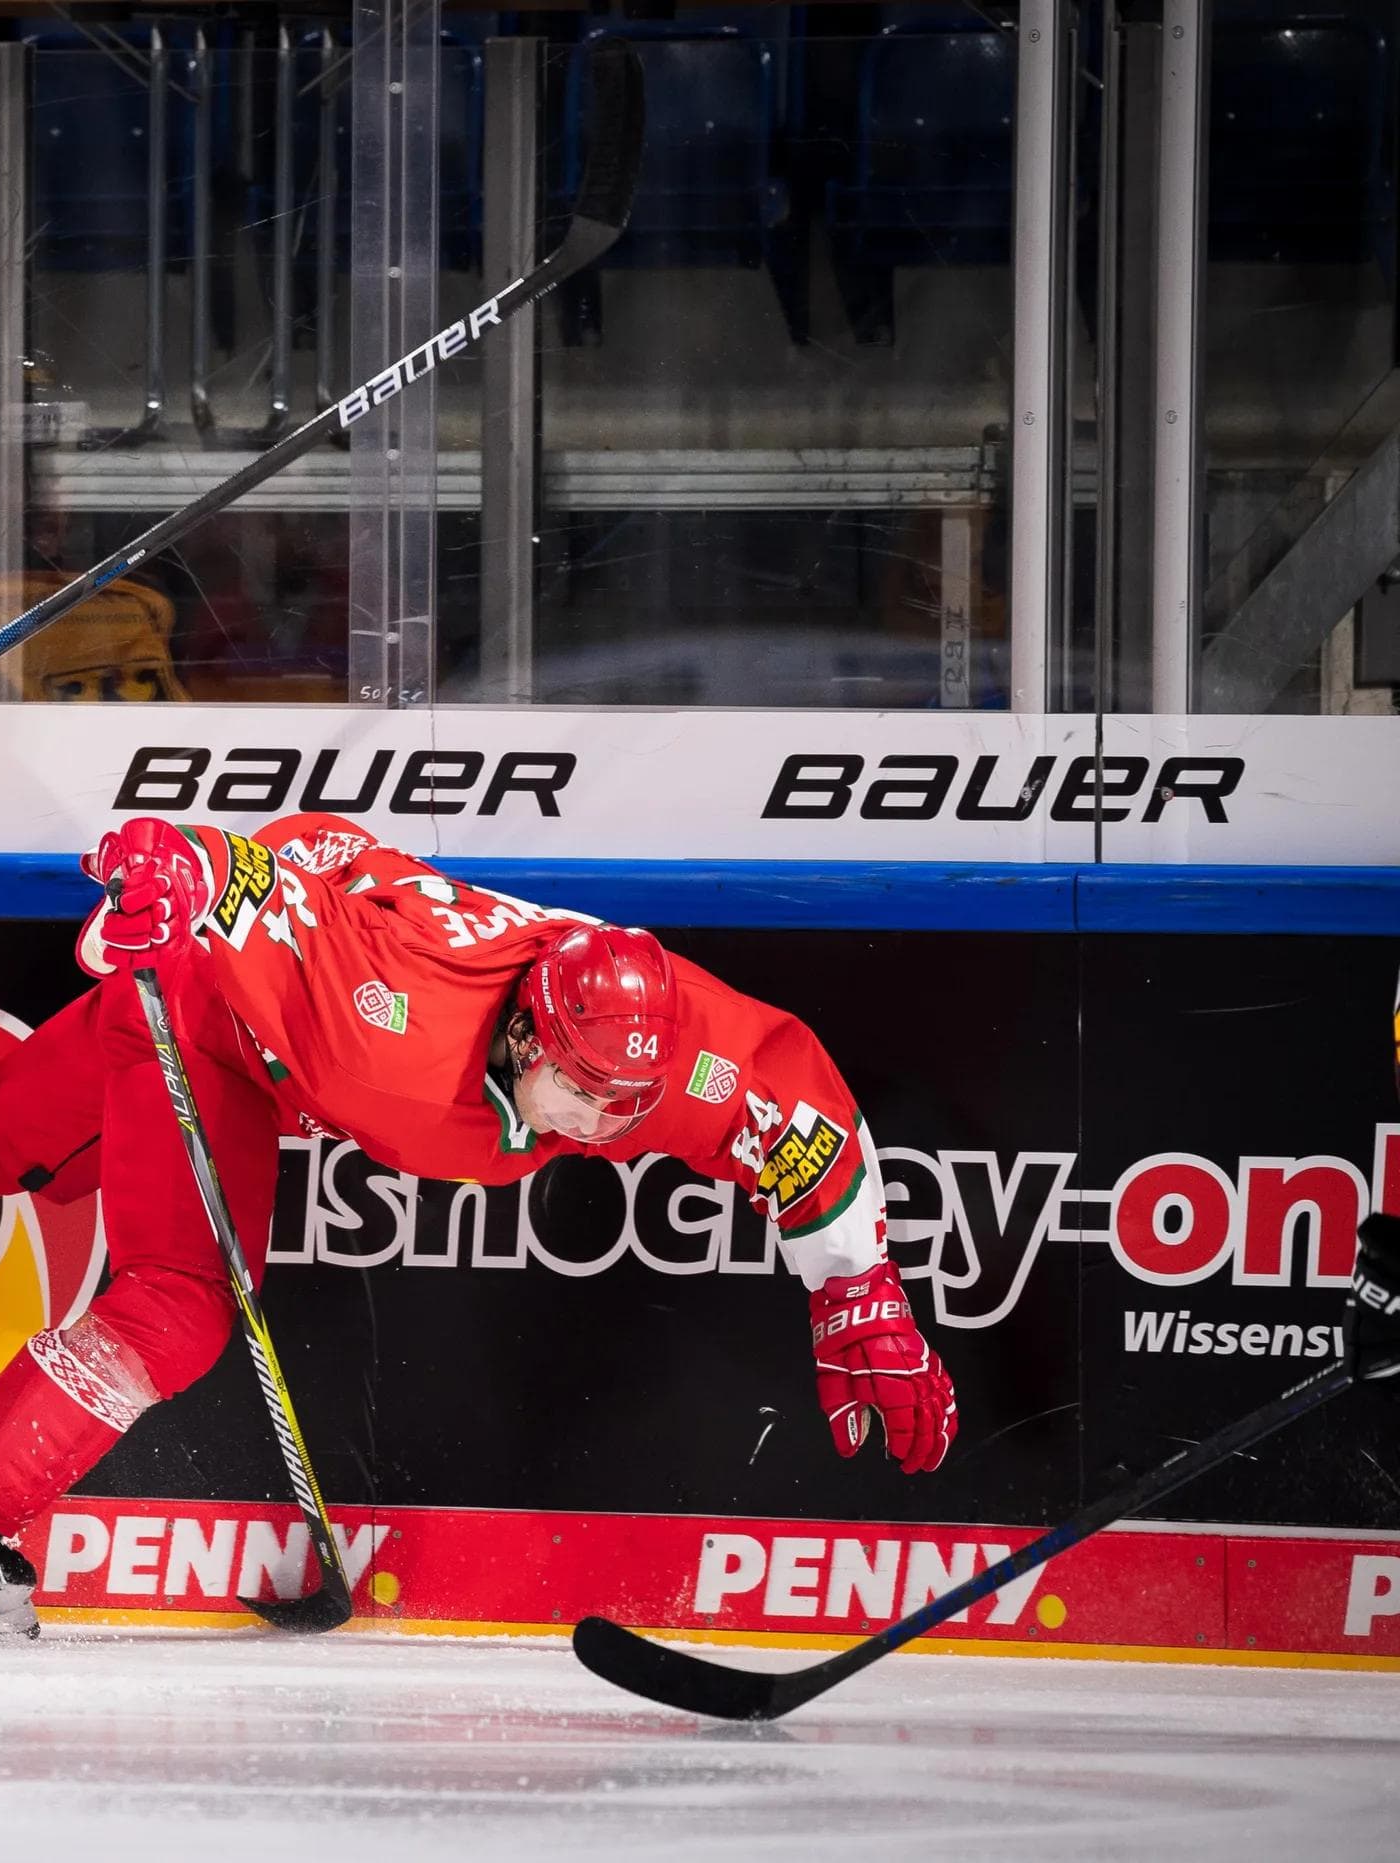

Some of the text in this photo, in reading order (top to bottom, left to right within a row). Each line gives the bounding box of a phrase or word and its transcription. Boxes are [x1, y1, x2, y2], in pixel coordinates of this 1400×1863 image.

[338, 299, 502, 428] BAUER
[112, 746, 577, 817] BAUER
[760, 754, 1245, 824] BAUER
[626, 1032, 658, 1060] 84
[694, 1057, 711, 1093] BELARUS
[155, 1043, 196, 1134] ALPHA
[758, 1132, 807, 1190] PARI
[777, 1124, 838, 1204] MATCH
